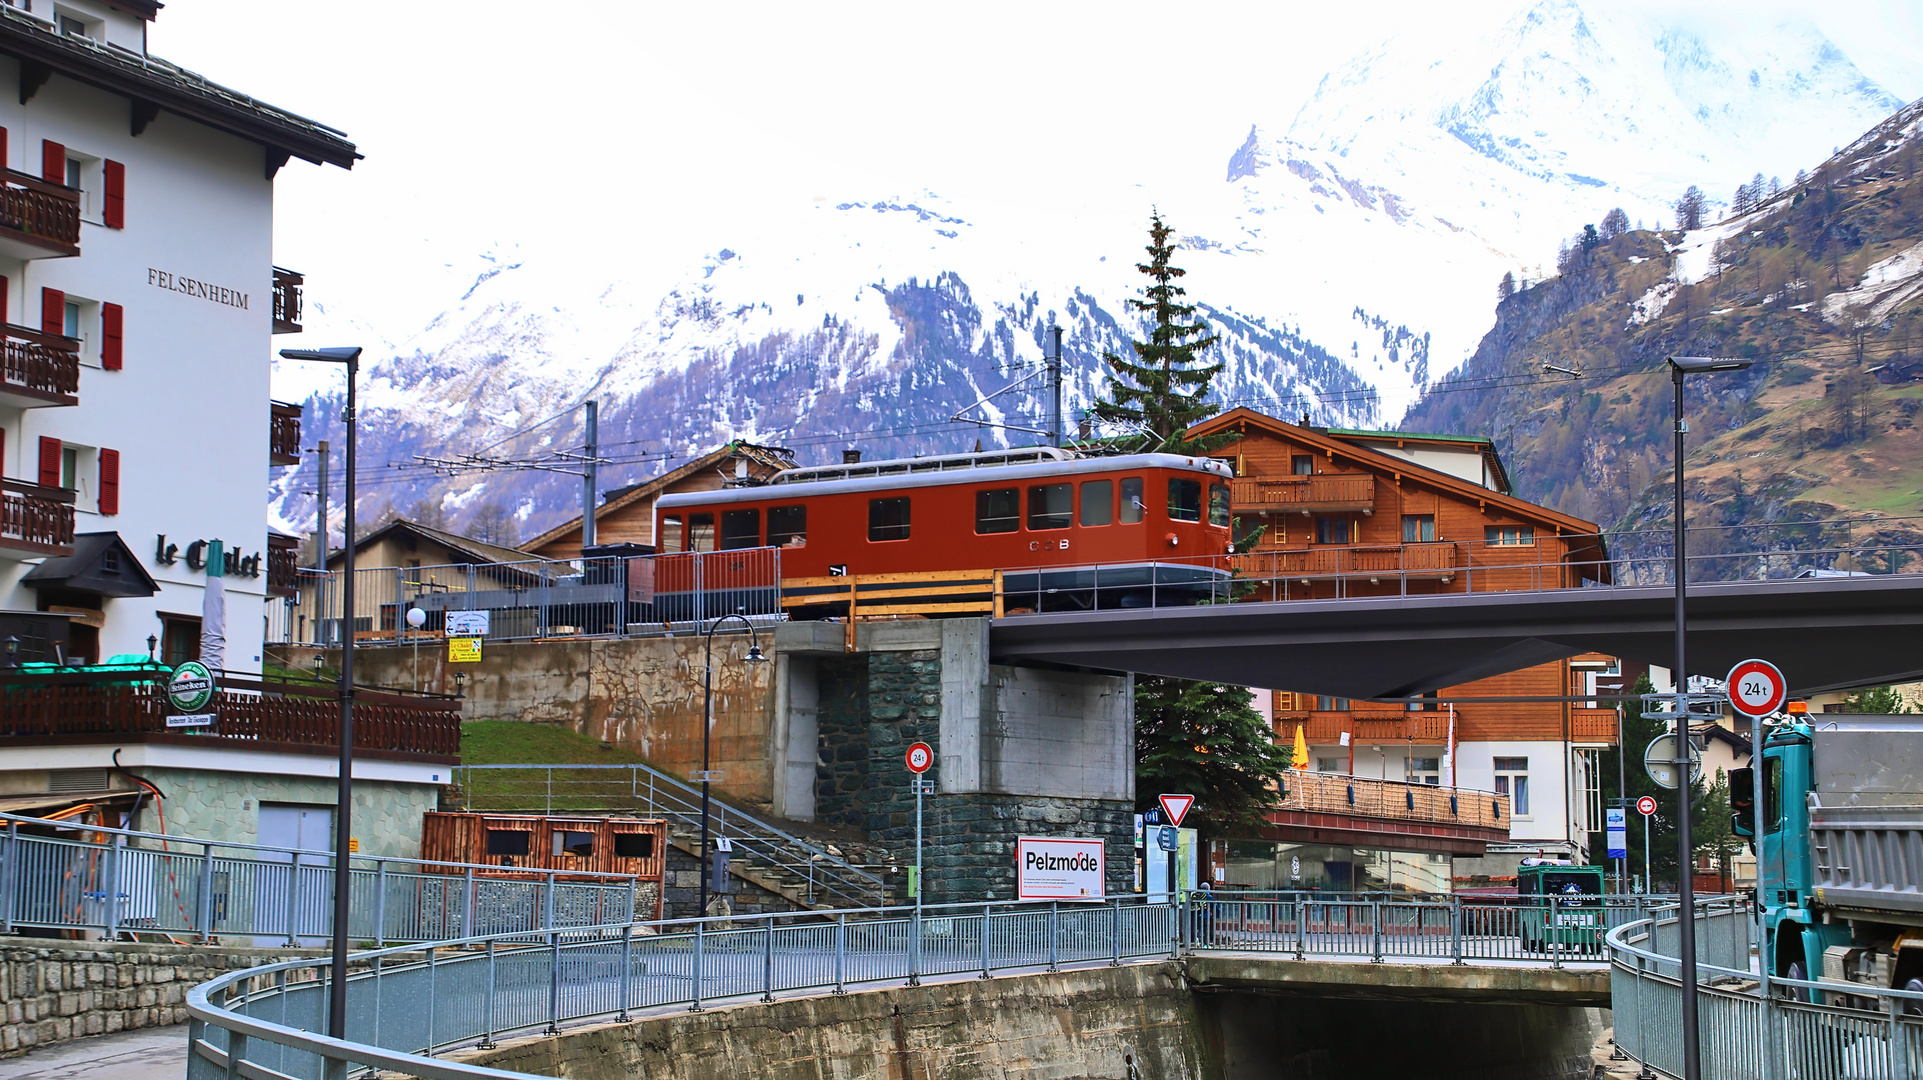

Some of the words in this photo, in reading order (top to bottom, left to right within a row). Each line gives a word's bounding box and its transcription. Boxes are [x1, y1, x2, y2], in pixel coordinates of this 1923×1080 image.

[148, 267, 249, 310] FELSENHEIM
[156, 534, 178, 565] le
[187, 539, 261, 578] Calet
